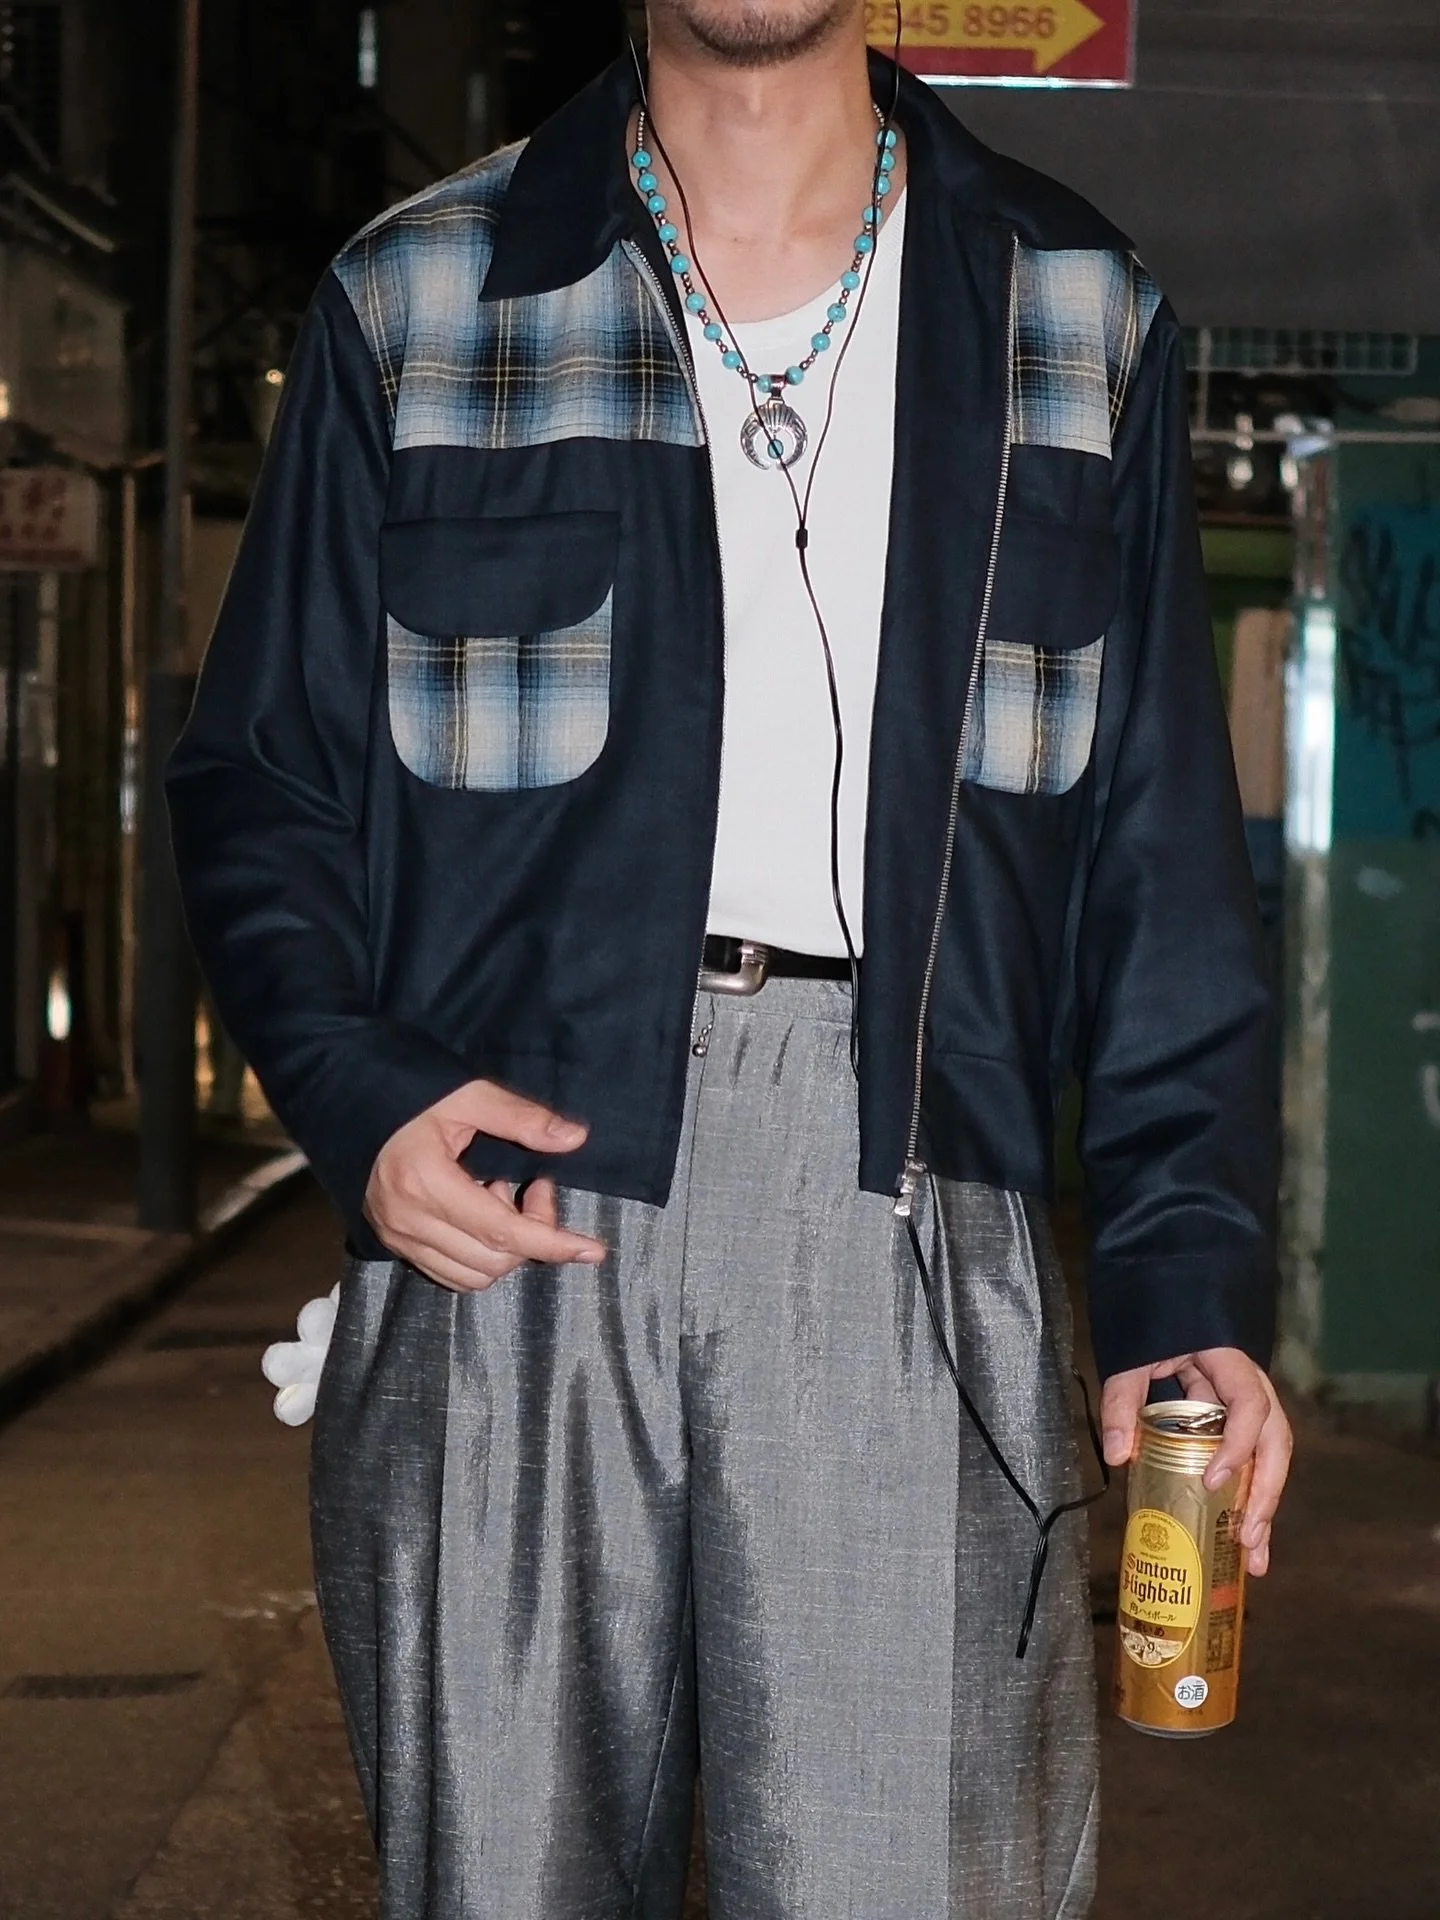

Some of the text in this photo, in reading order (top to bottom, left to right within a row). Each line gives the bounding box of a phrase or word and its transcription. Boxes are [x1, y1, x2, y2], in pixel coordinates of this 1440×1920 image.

[864, 3, 950, 36] 2545
[1126, 1552, 1187, 1586] Suntory
[1123, 1569, 1192, 1605] Highball
[1177, 1684, 1205, 1701] お酒
